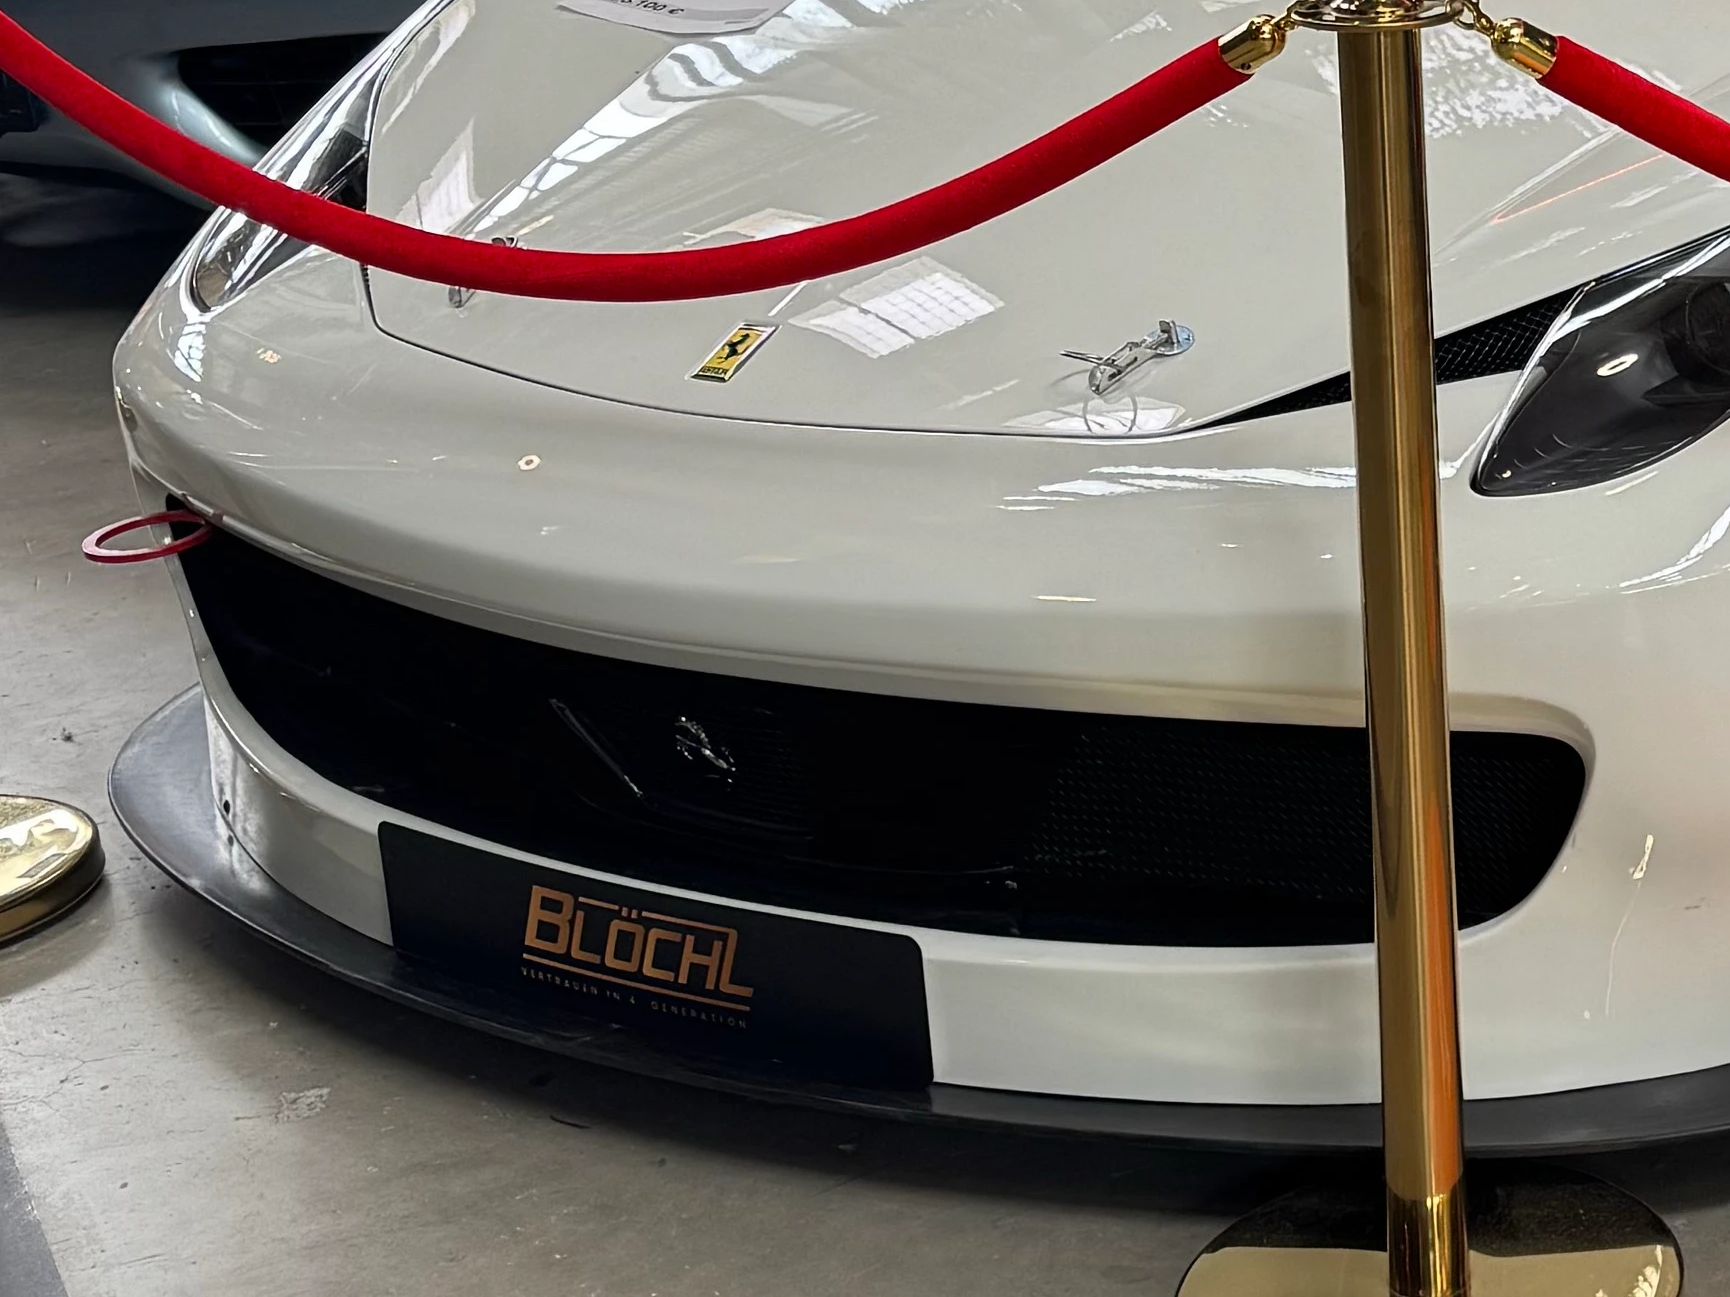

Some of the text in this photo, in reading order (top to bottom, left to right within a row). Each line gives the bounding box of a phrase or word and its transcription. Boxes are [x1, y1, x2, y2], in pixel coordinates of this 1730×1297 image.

[524, 885, 754, 998] BLÖCHL
[520, 966, 598, 996] VERTRAUEN
[650, 1001, 747, 1029] GENERATION
